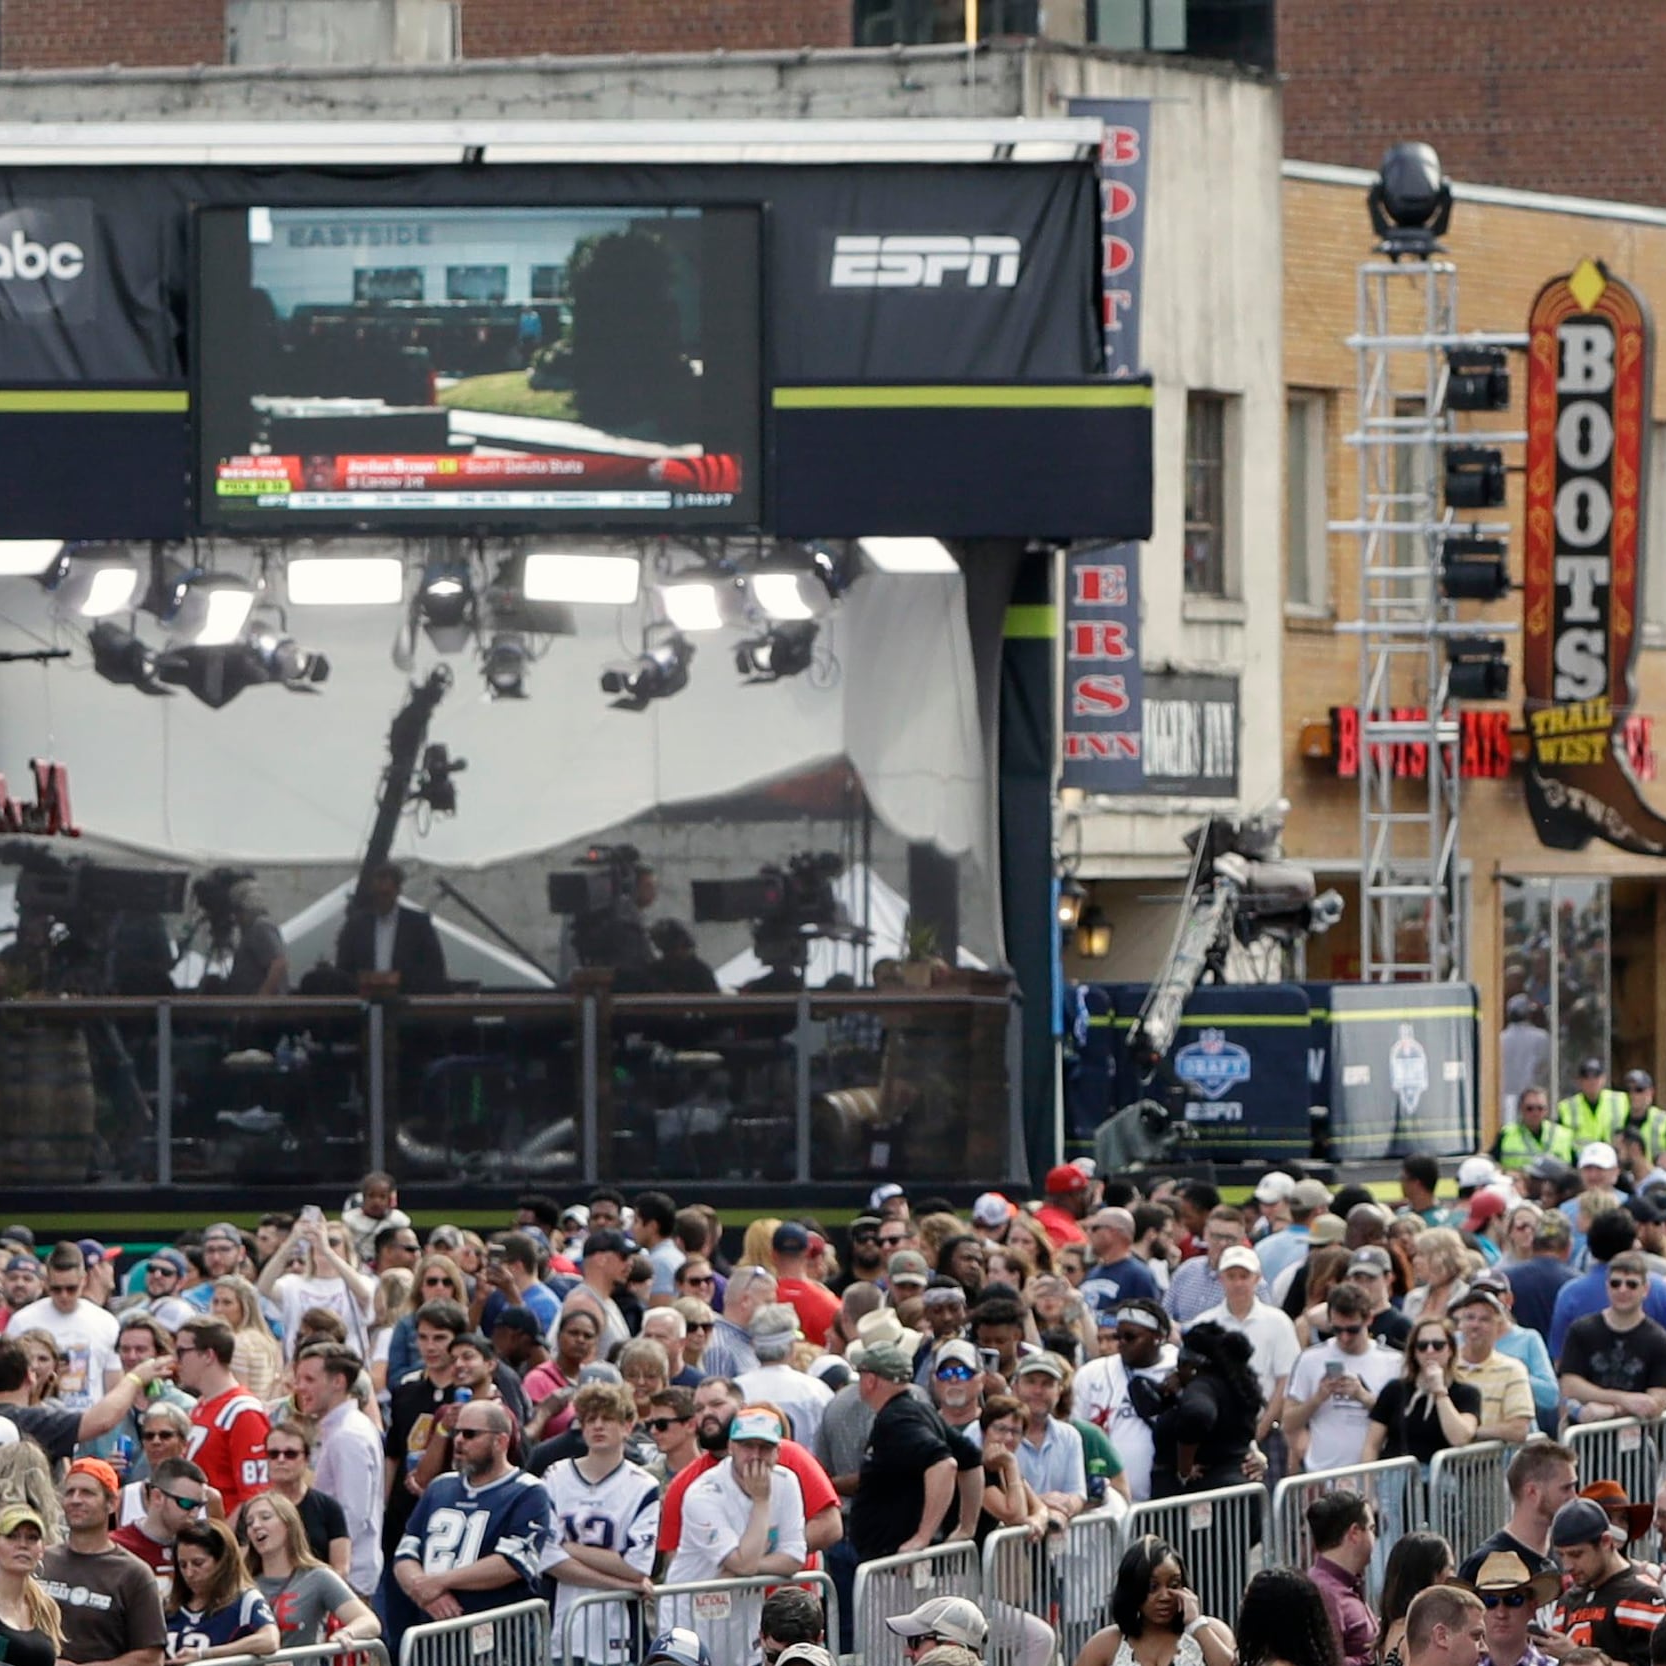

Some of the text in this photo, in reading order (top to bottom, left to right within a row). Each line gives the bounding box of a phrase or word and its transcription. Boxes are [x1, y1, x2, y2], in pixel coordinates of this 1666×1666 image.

[286, 224, 435, 248] EASTSIDE
[831, 236, 1020, 286] ESPN
[1555, 322, 1615, 702] BOOTS
[1532, 697, 1612, 736] TRAIL
[1537, 733, 1608, 764] WEST
[1183, 1102, 1242, 1121] ESPN
[240, 1457, 265, 1482] 87
[424, 1507, 488, 1573] 21
